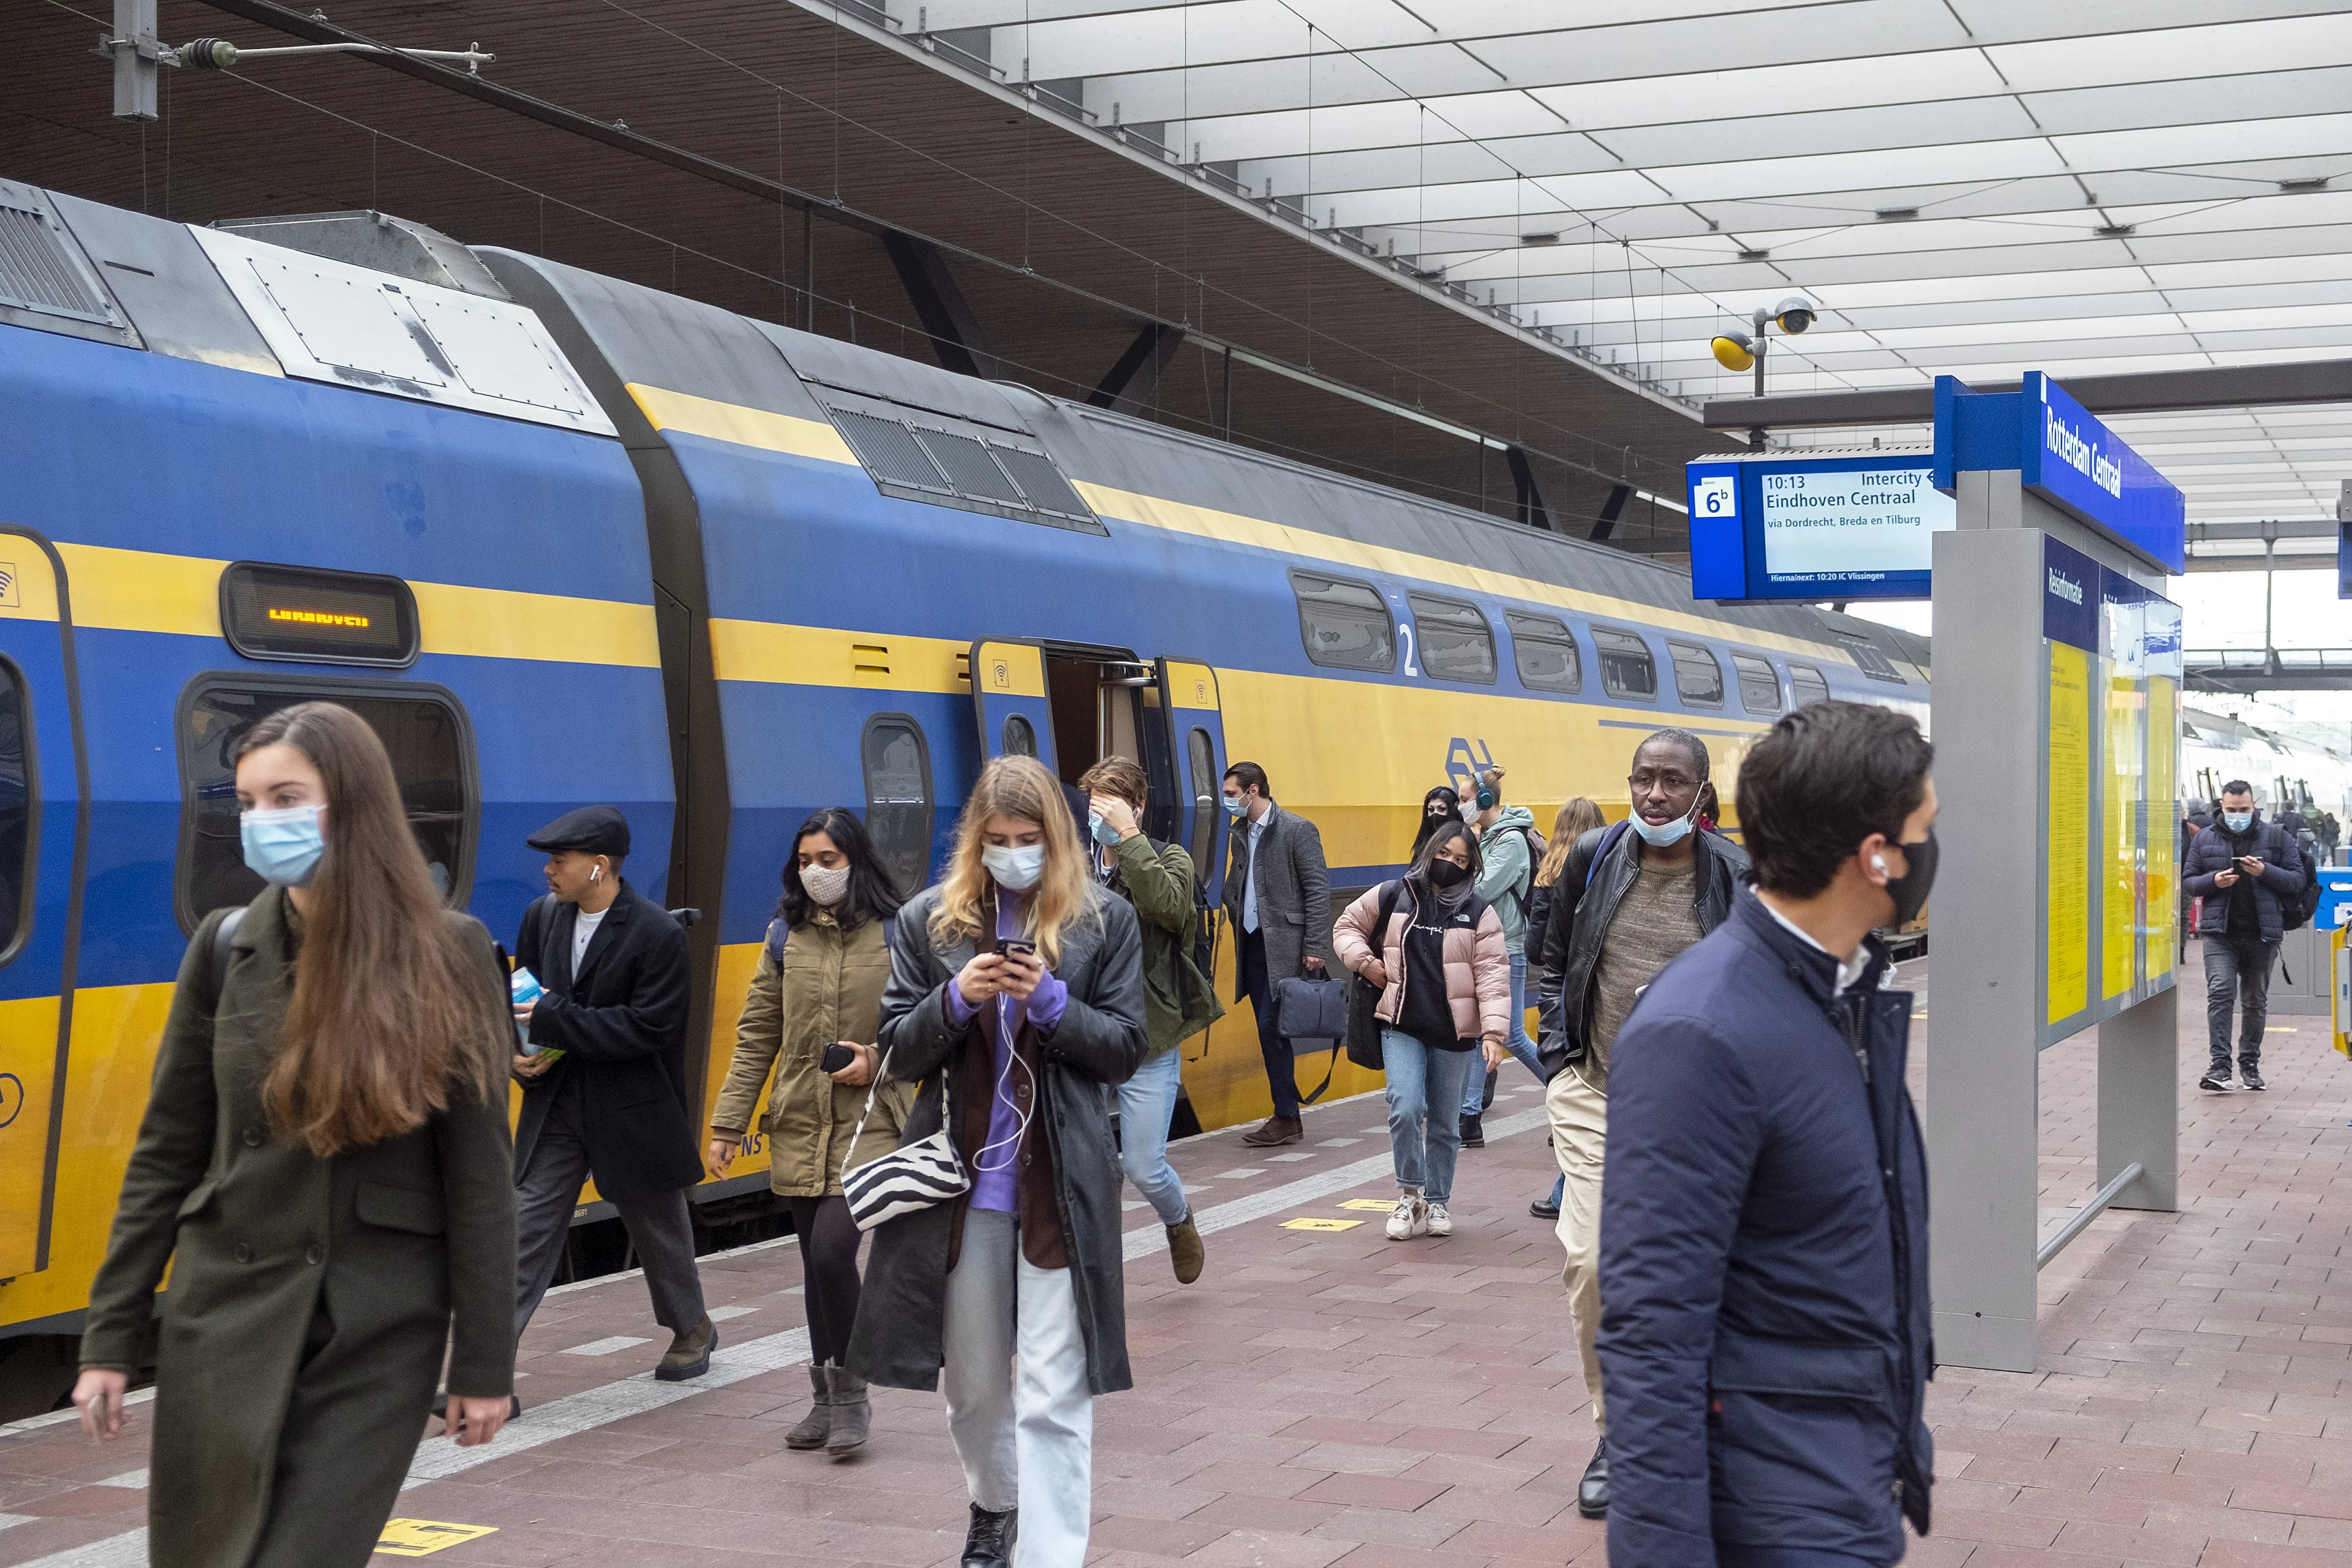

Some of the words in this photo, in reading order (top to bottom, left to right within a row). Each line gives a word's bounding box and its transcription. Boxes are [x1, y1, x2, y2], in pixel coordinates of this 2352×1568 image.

[2046, 405, 2090, 477] Rotterdam
[2091, 442, 2121, 499] Centraal
[1767, 476, 1805, 489] 10:13
[1862, 471, 1922, 488] Intercity
[1767, 492, 1845, 508] Eindhoven
[1850, 489, 1915, 505] Centraal
[1768, 519, 1782, 528] via
[1785, 518, 1836, 527] Dordrecht,
[1839, 517, 1868, 526] Breda
[1886, 515, 1921, 526] Tilburg
[1847, 572, 1885, 581] Vlissingen
[2049, 567, 2082, 606] Reisinformatie
[1399, 624, 1417, 677] 2
[741, 1133, 763, 1157] NS
